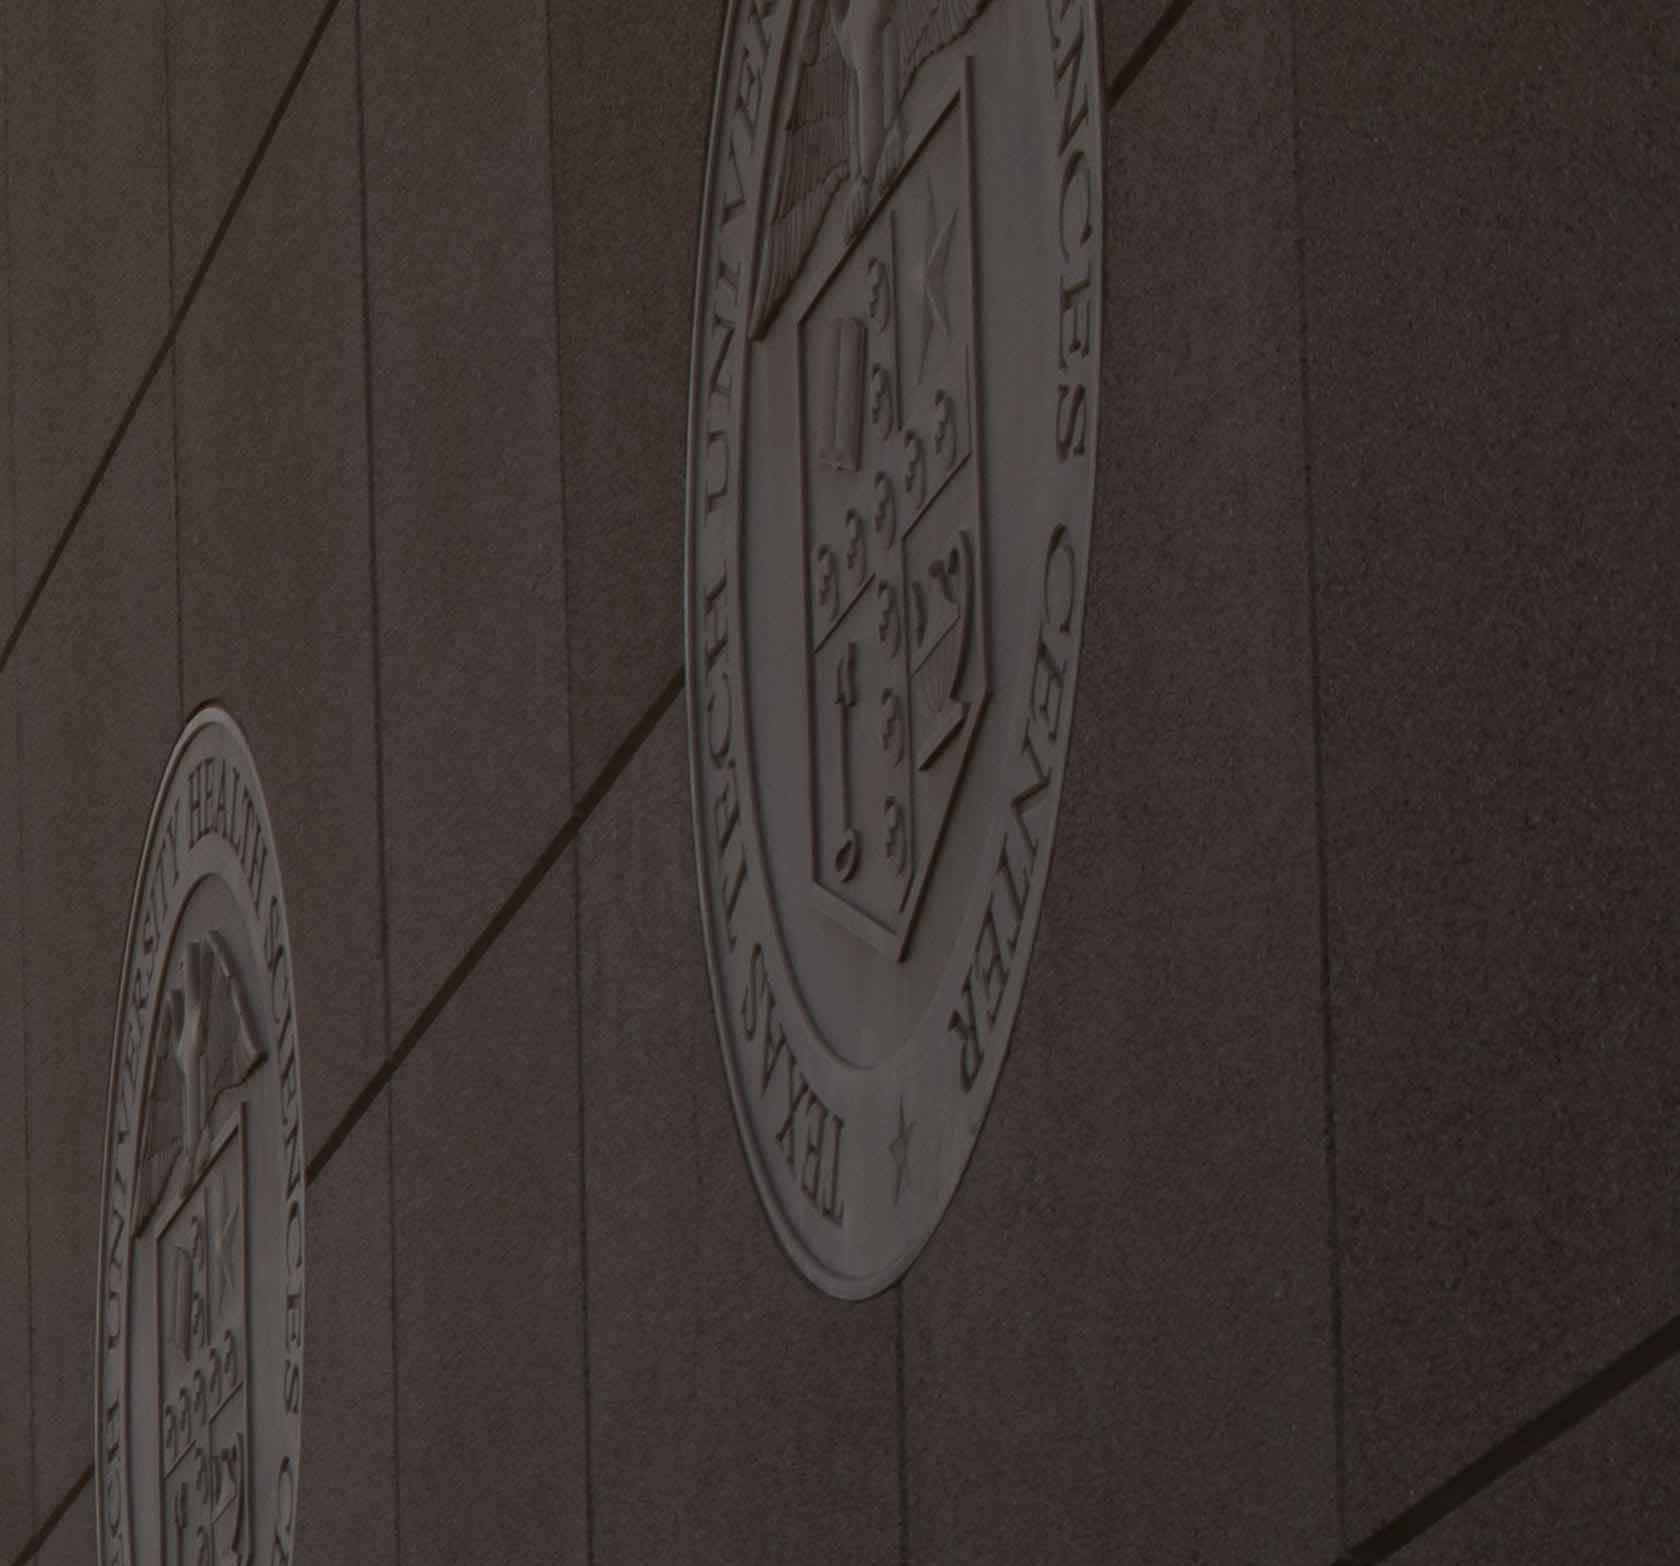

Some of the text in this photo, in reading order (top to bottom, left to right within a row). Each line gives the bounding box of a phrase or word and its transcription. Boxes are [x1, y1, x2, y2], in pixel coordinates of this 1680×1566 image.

[703, 560, 750, 952] TECH
[946, 522, 1075, 1095] CENTER
[105, 796, 179, 1358] UNIVERSITY
[188, 756, 268, 919] HEALTH
[264, 896, 302, 1414] SCIENCES
[741, 942, 845, 1229] TEXAS
